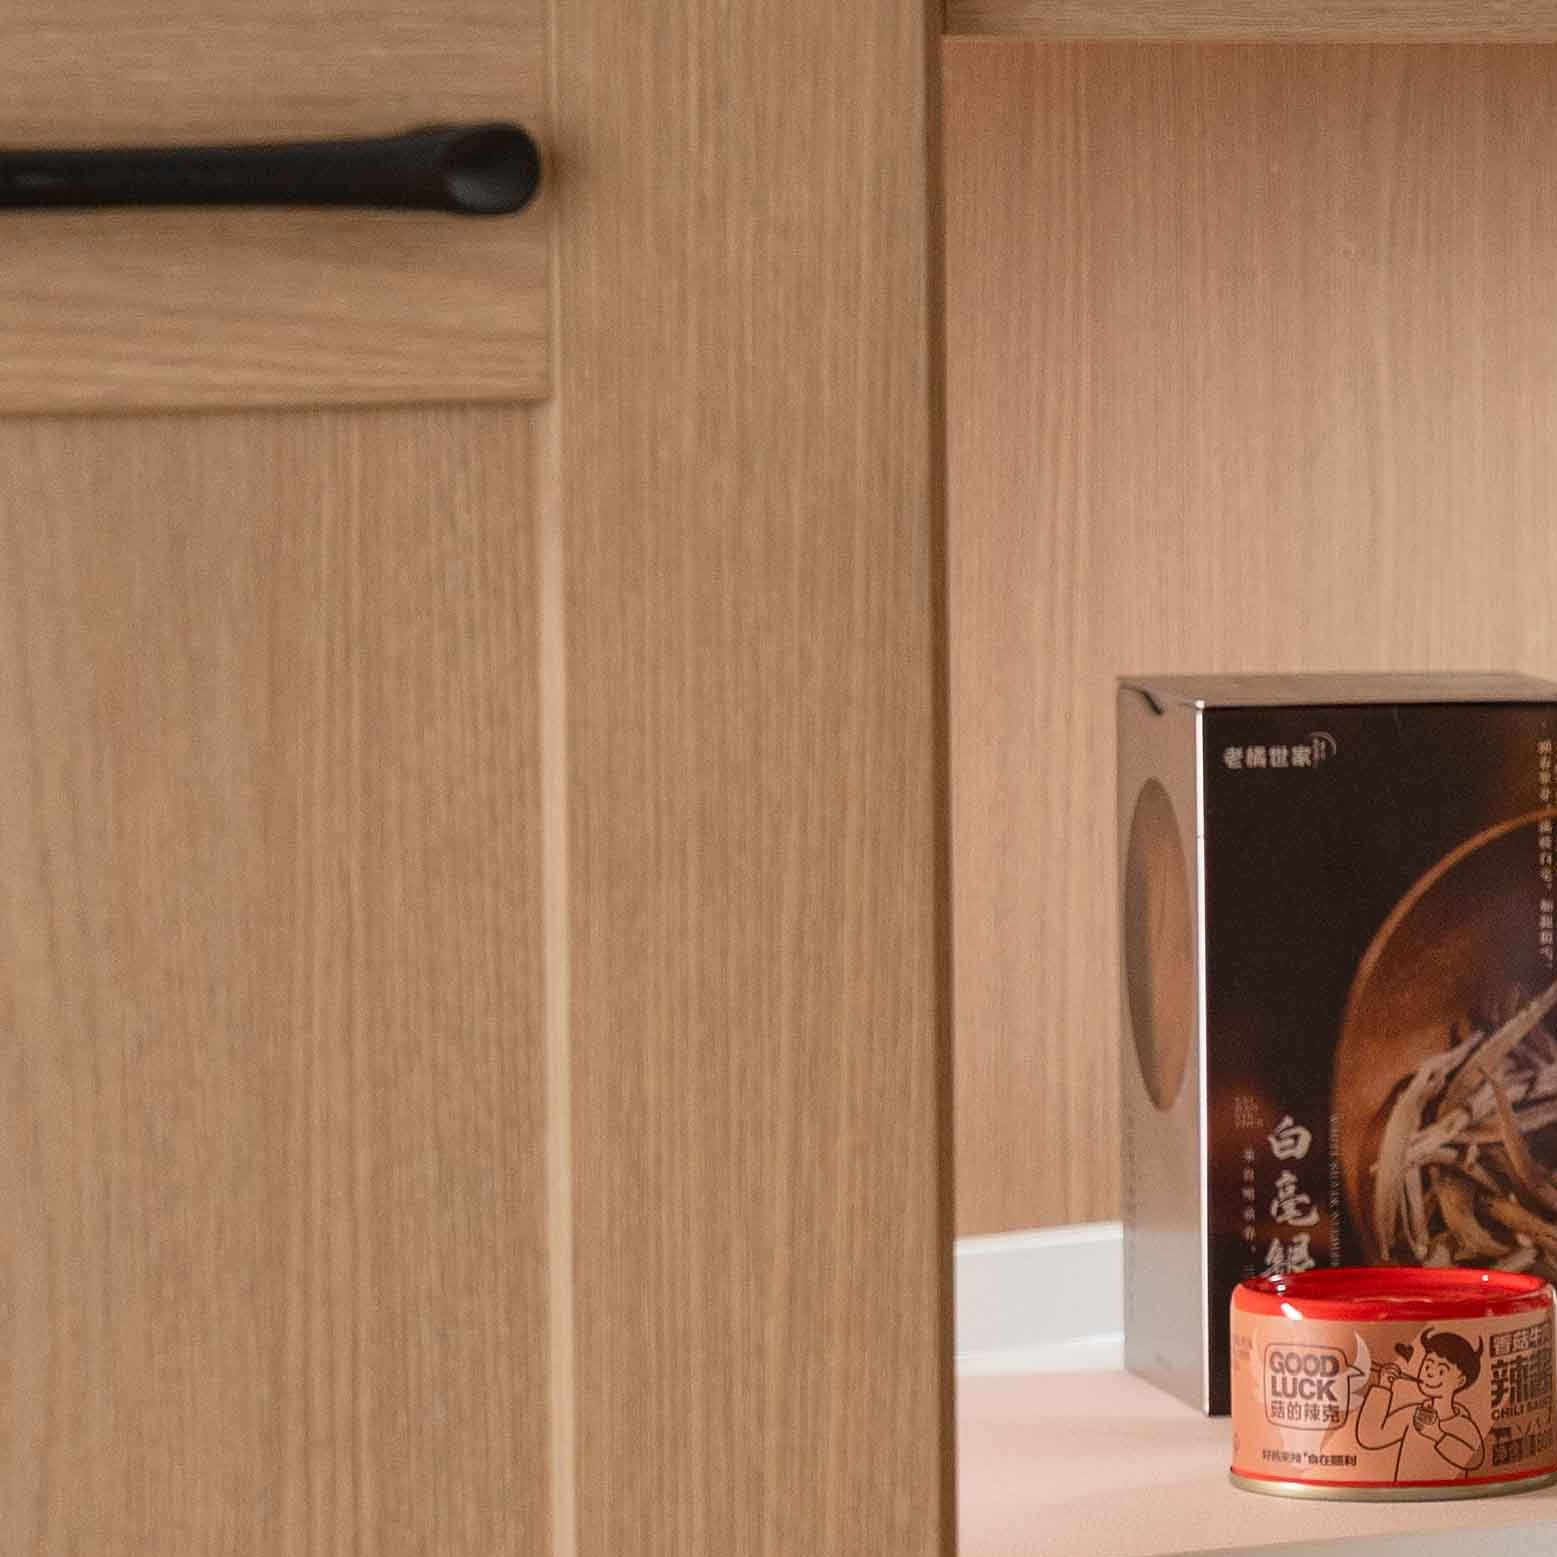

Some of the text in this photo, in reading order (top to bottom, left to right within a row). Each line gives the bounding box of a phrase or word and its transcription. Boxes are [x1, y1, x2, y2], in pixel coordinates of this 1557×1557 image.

[1269, 1351, 1341, 1378] GOOD
[1270, 1375, 1338, 1403] LUCK
[1269, 1400, 1341, 1424] 菇的辣克
